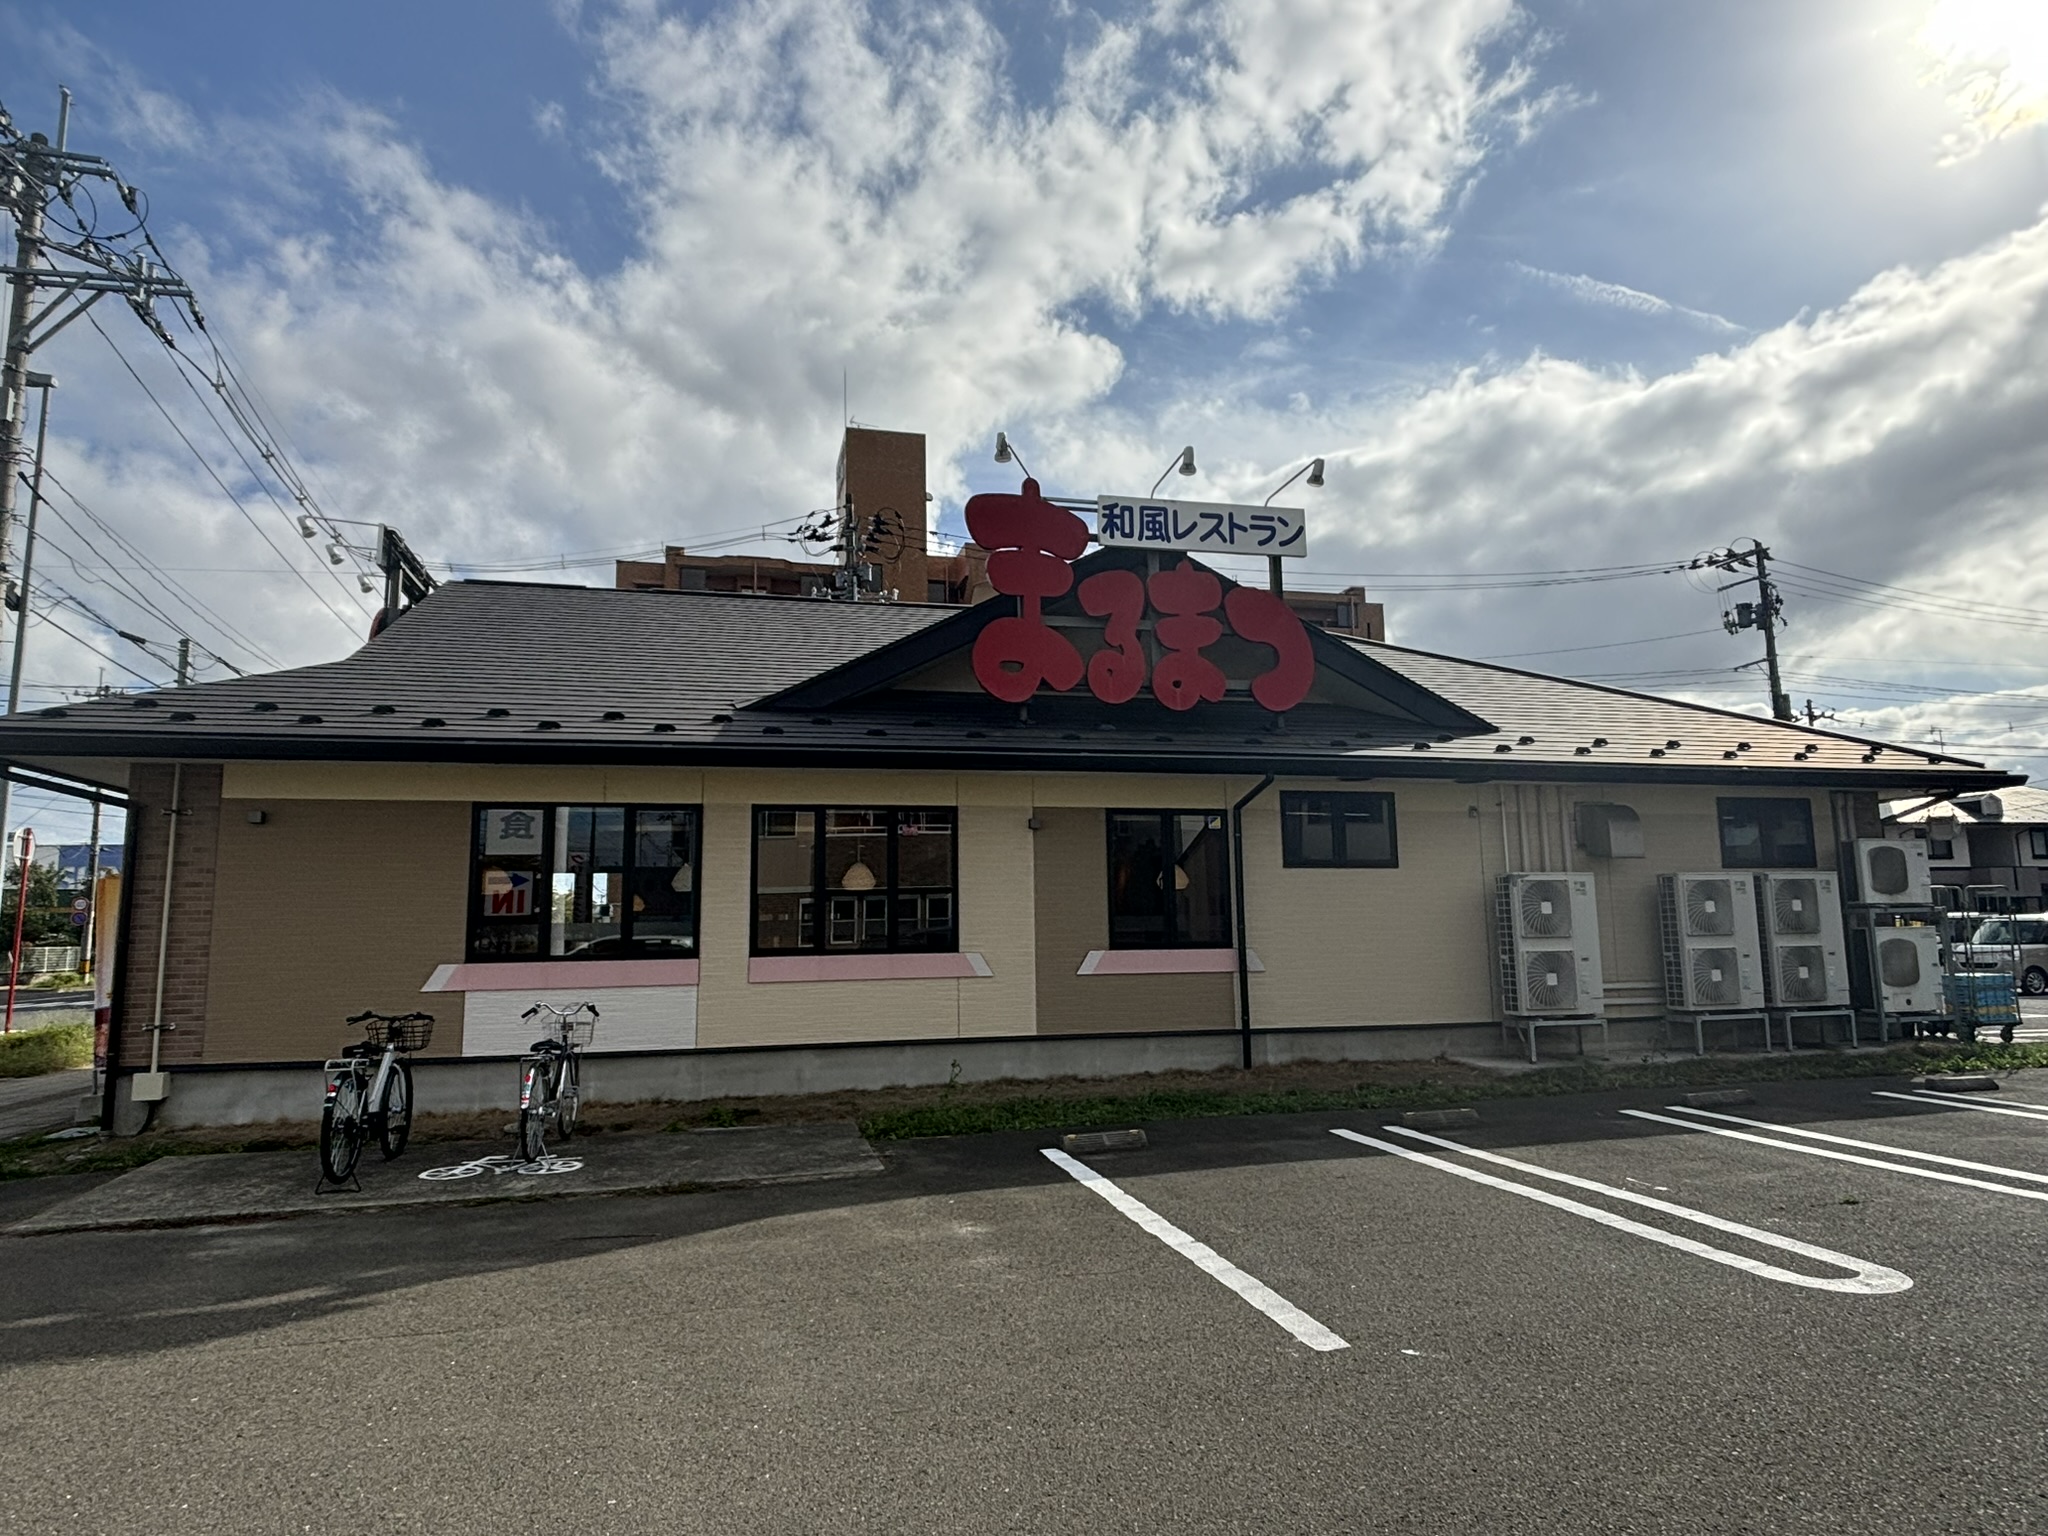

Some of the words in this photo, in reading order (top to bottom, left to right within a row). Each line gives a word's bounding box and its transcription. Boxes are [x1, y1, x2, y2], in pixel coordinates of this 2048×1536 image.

[965, 477, 1315, 711] まるまつ
[1101, 502, 1304, 547] 和風レストラン
